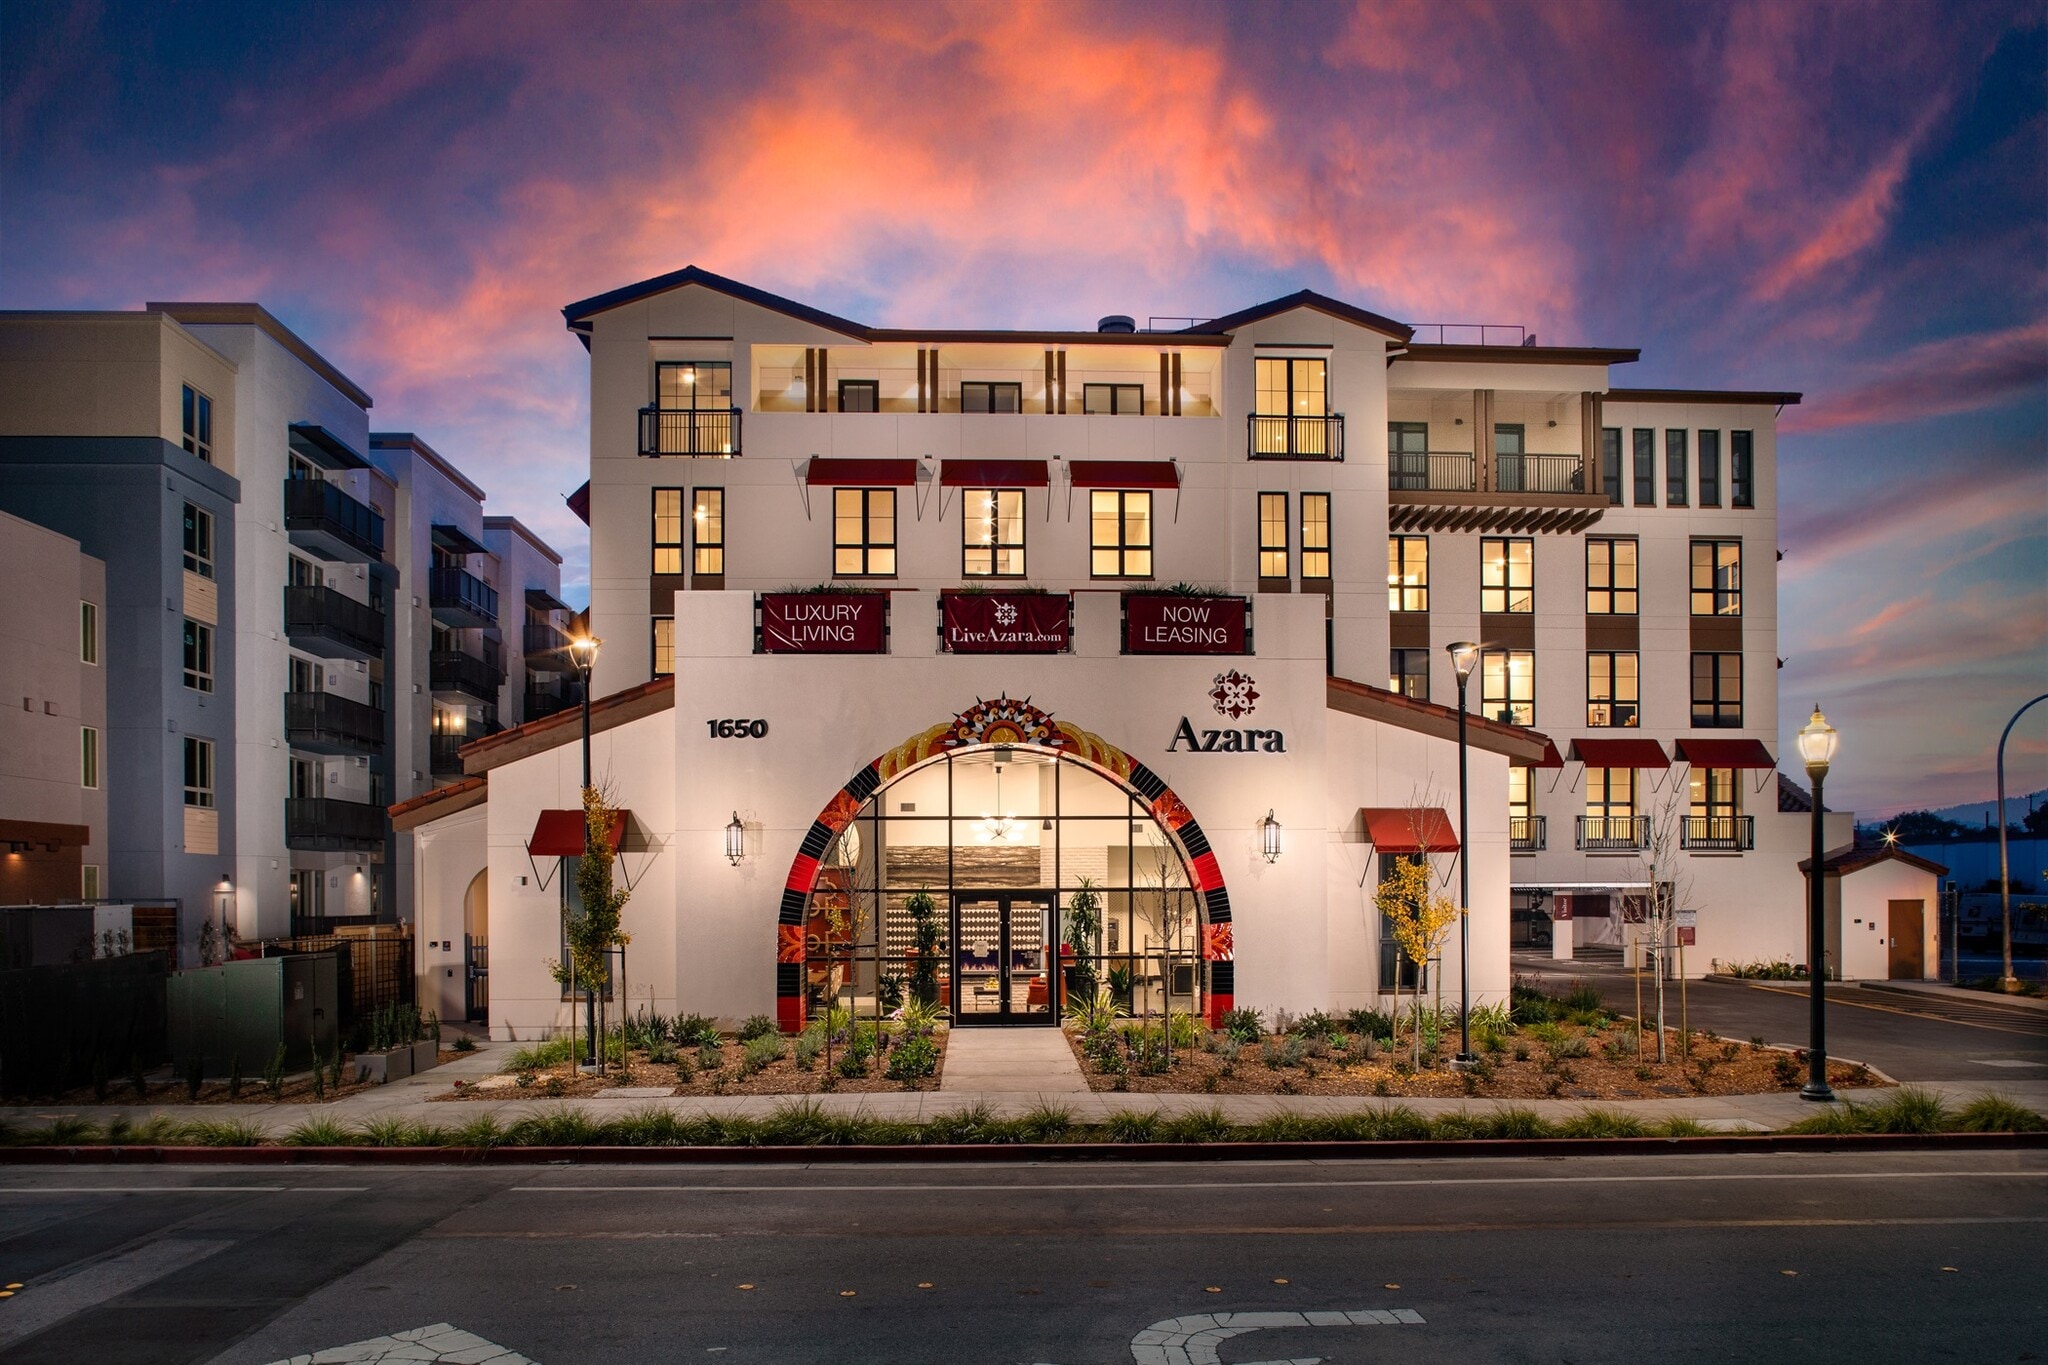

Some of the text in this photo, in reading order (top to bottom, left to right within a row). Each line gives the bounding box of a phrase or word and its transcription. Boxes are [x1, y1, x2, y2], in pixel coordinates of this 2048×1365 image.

[784, 604, 863, 621] LUXURY
[1163, 606, 1211, 623] NOW
[791, 625, 855, 642] LIVING
[951, 626, 1062, 643] LiveAzara.com
[1144, 626, 1228, 644] LEASING
[706, 718, 769, 739] 1650
[1164, 715, 1288, 753] Azara
